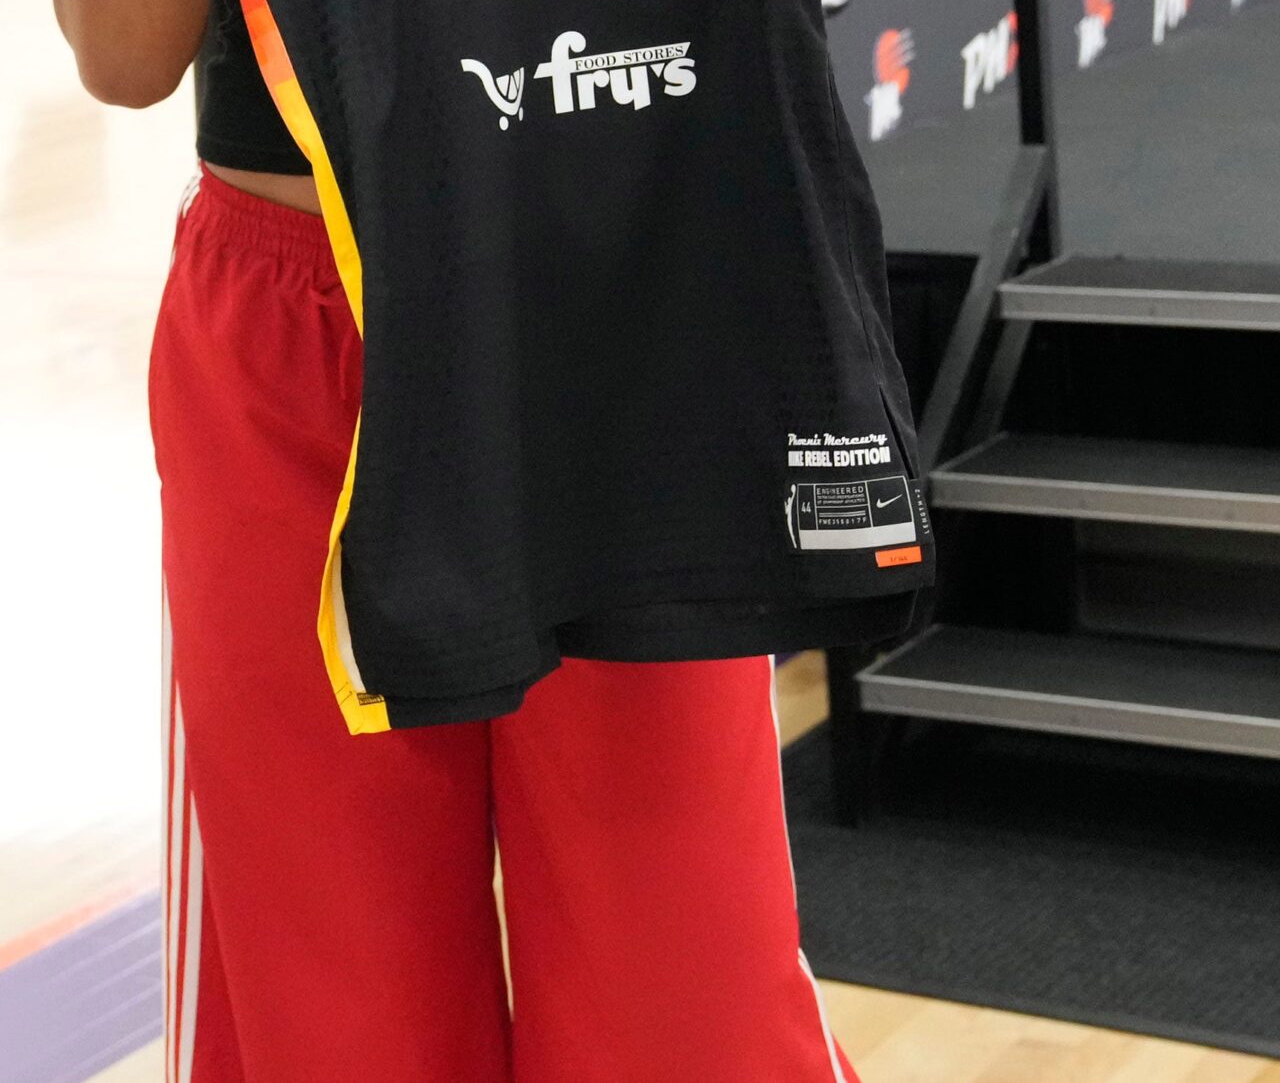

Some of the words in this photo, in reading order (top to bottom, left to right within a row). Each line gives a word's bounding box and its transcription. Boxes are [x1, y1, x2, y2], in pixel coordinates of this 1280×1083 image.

[574, 56, 617, 71] FOOD
[623, 45, 685, 64] STORES
[533, 30, 697, 115] fry's
[823, 433, 888, 446] Mercury
[833, 446, 891, 467] EDITION
[816, 485, 864, 496] ENGINEERED
